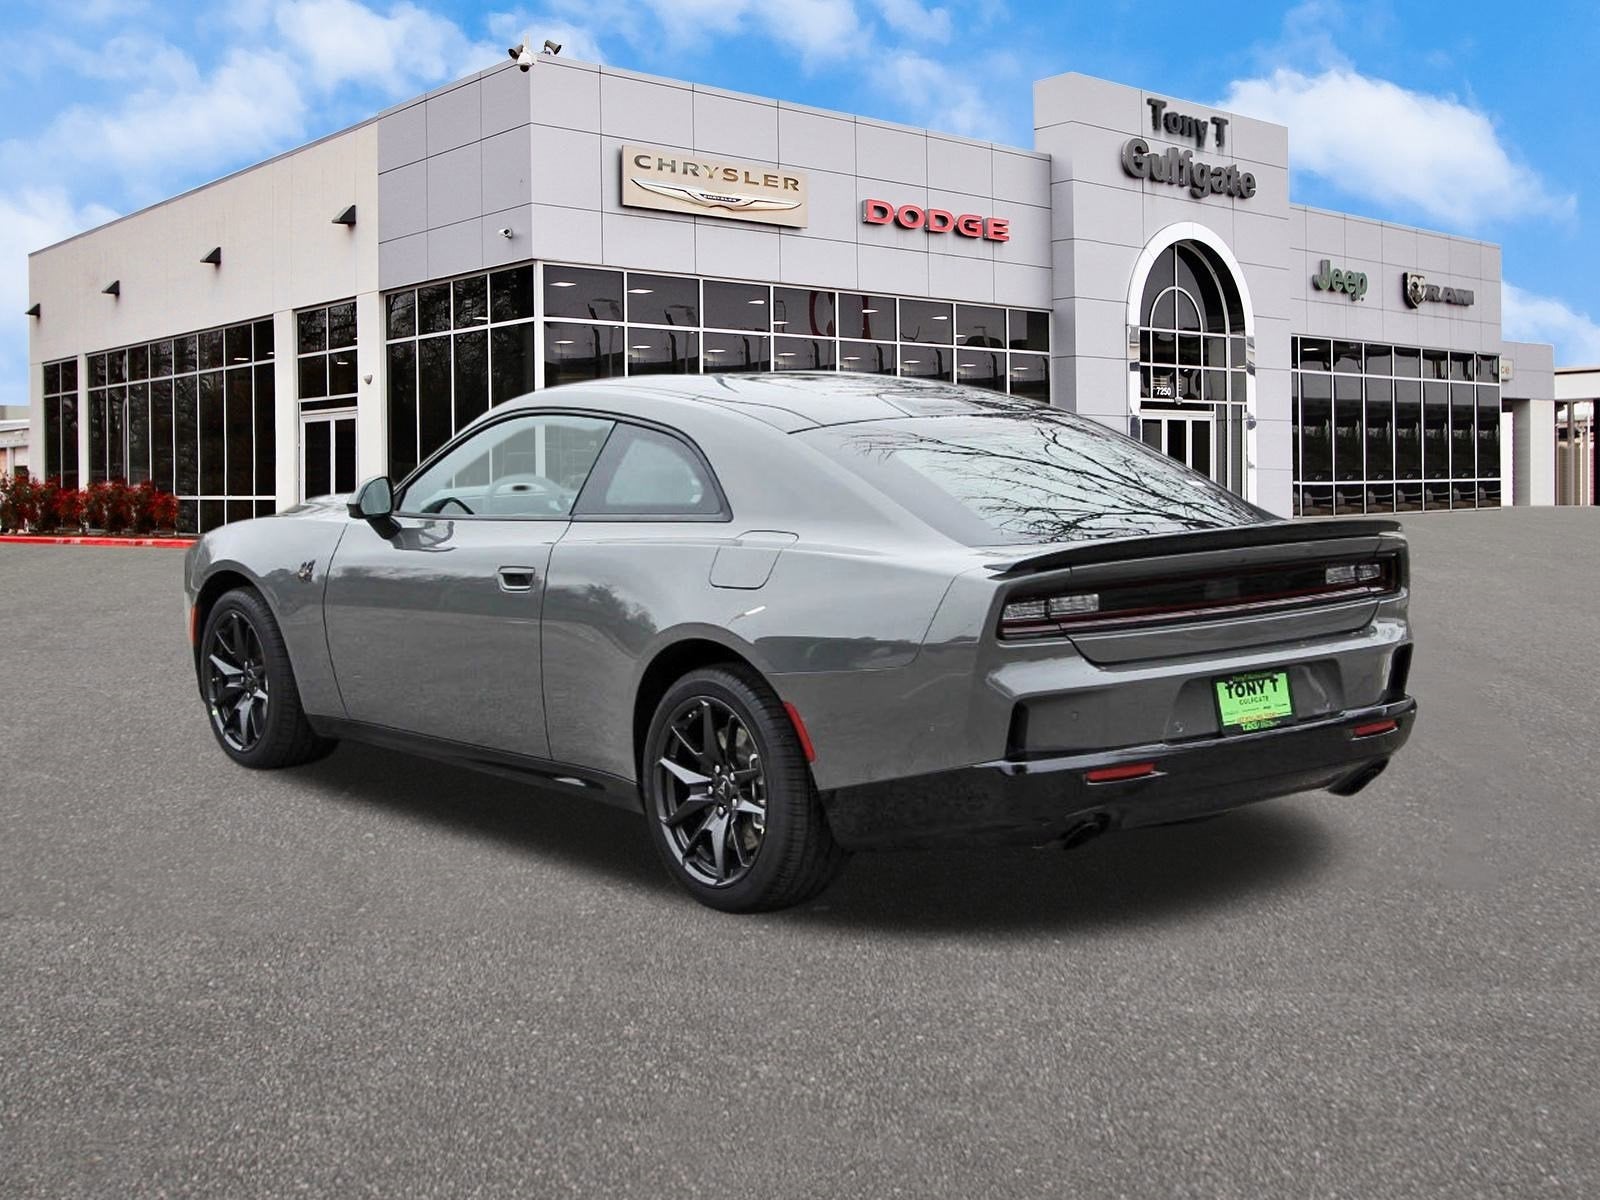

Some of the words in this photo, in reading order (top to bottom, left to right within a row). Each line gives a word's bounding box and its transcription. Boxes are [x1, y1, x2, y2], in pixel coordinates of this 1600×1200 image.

[1147, 98, 1208, 148] Tony
[1211, 117, 1229, 148] T
[633, 154, 800, 192] CHRYSLER
[1121, 138, 1257, 199] Gulfgate
[862, 199, 1010, 242] DODGE
[1312, 259, 1368, 302] Jeep
[1425, 284, 1475, 307] RAM
[1156, 386, 1172, 396] 7250
[1225, 680, 1266, 699] TONY
[1269, 678, 1279, 693] T
